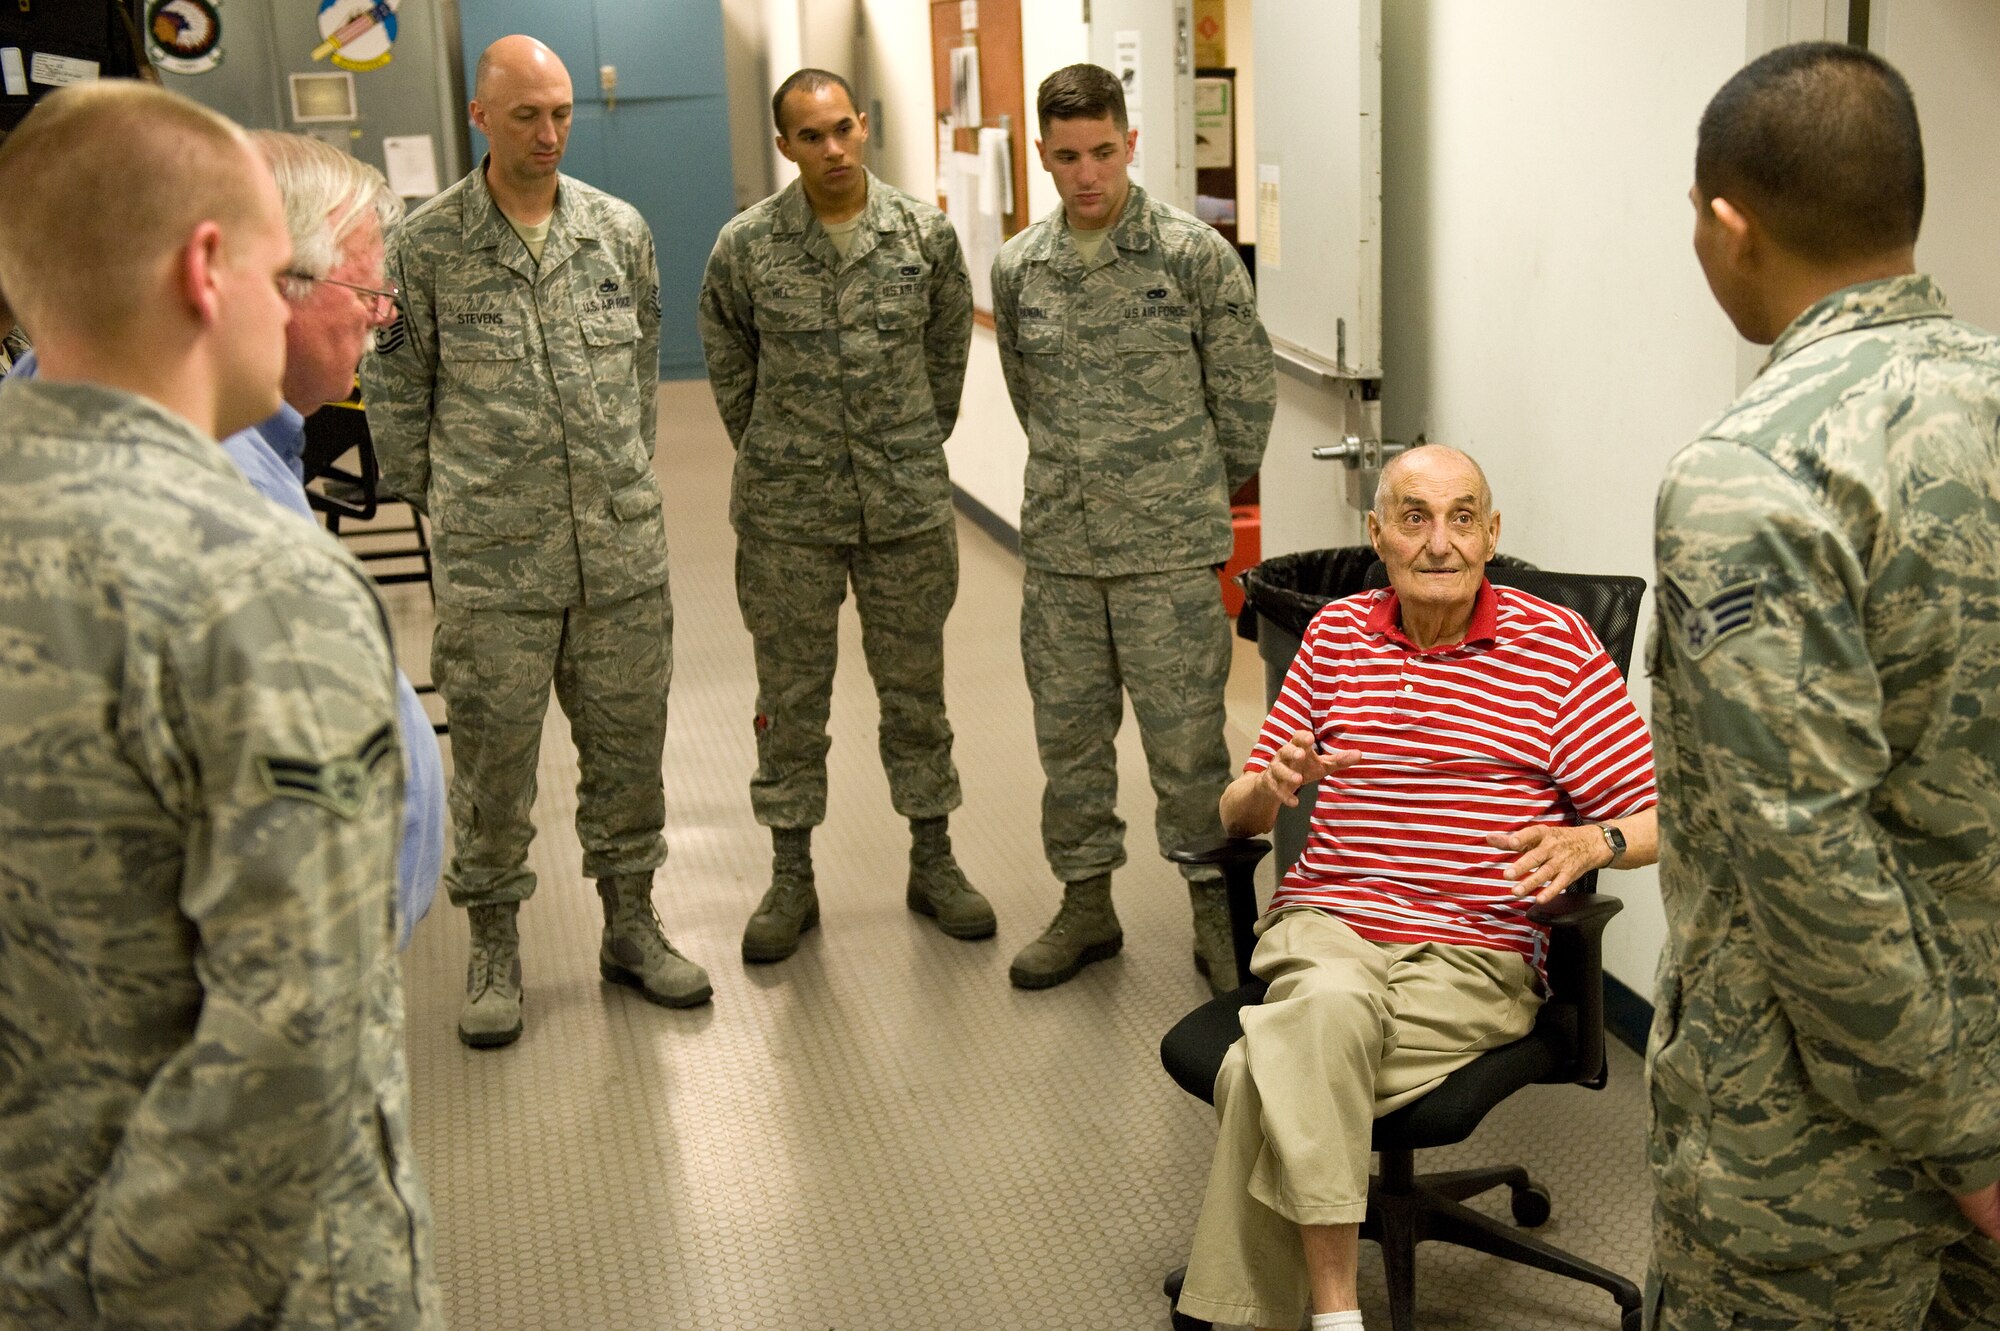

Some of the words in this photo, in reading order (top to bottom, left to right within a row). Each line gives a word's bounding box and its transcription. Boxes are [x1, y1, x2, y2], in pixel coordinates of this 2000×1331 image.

[582, 301, 599, 312] U.S.
[1142, 306, 1156, 317] AIR
[1158, 305, 1187, 317] FORCE
[457, 312, 503, 325] STEVENS
